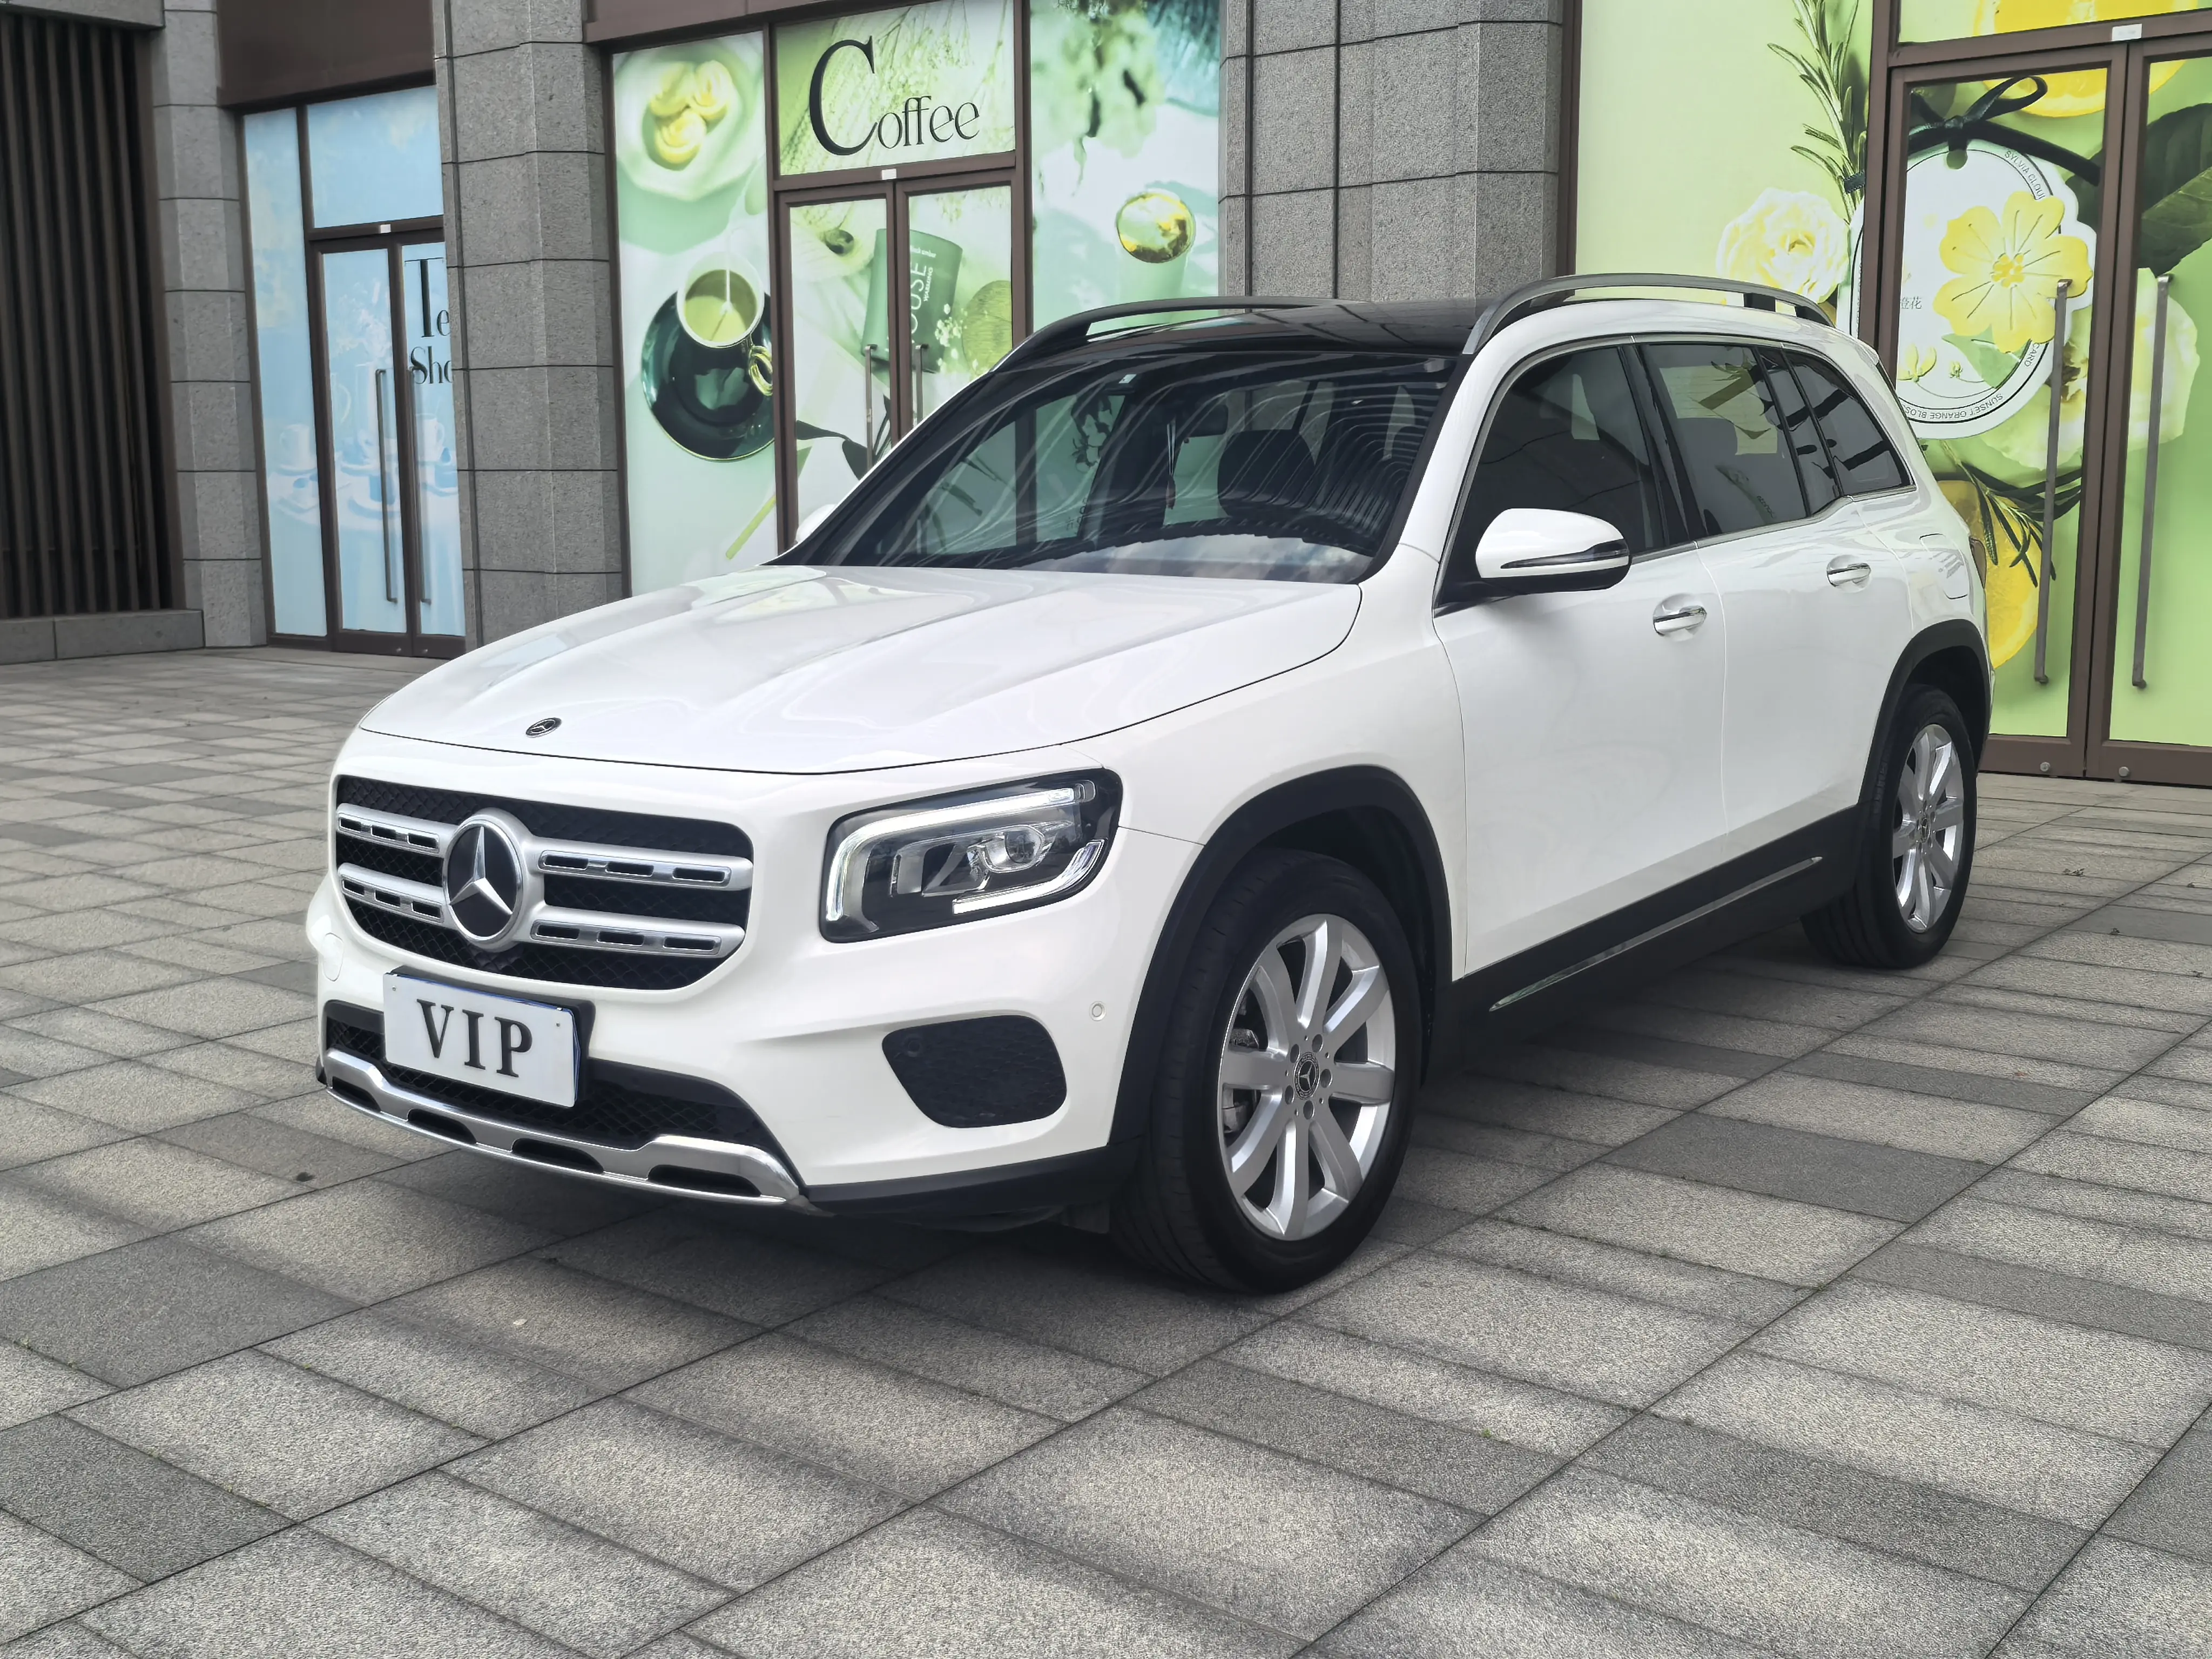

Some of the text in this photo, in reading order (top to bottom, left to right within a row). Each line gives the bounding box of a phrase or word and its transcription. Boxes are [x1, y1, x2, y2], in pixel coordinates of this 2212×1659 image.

[809, 35, 980, 156] Coffee
[2004, 150, 2029, 173] SYLVIA
[1929, 410, 1967, 419] ORANGE
[1969, 393, 2004, 416] SUNSET
[416, 999, 532, 1078] VIP
